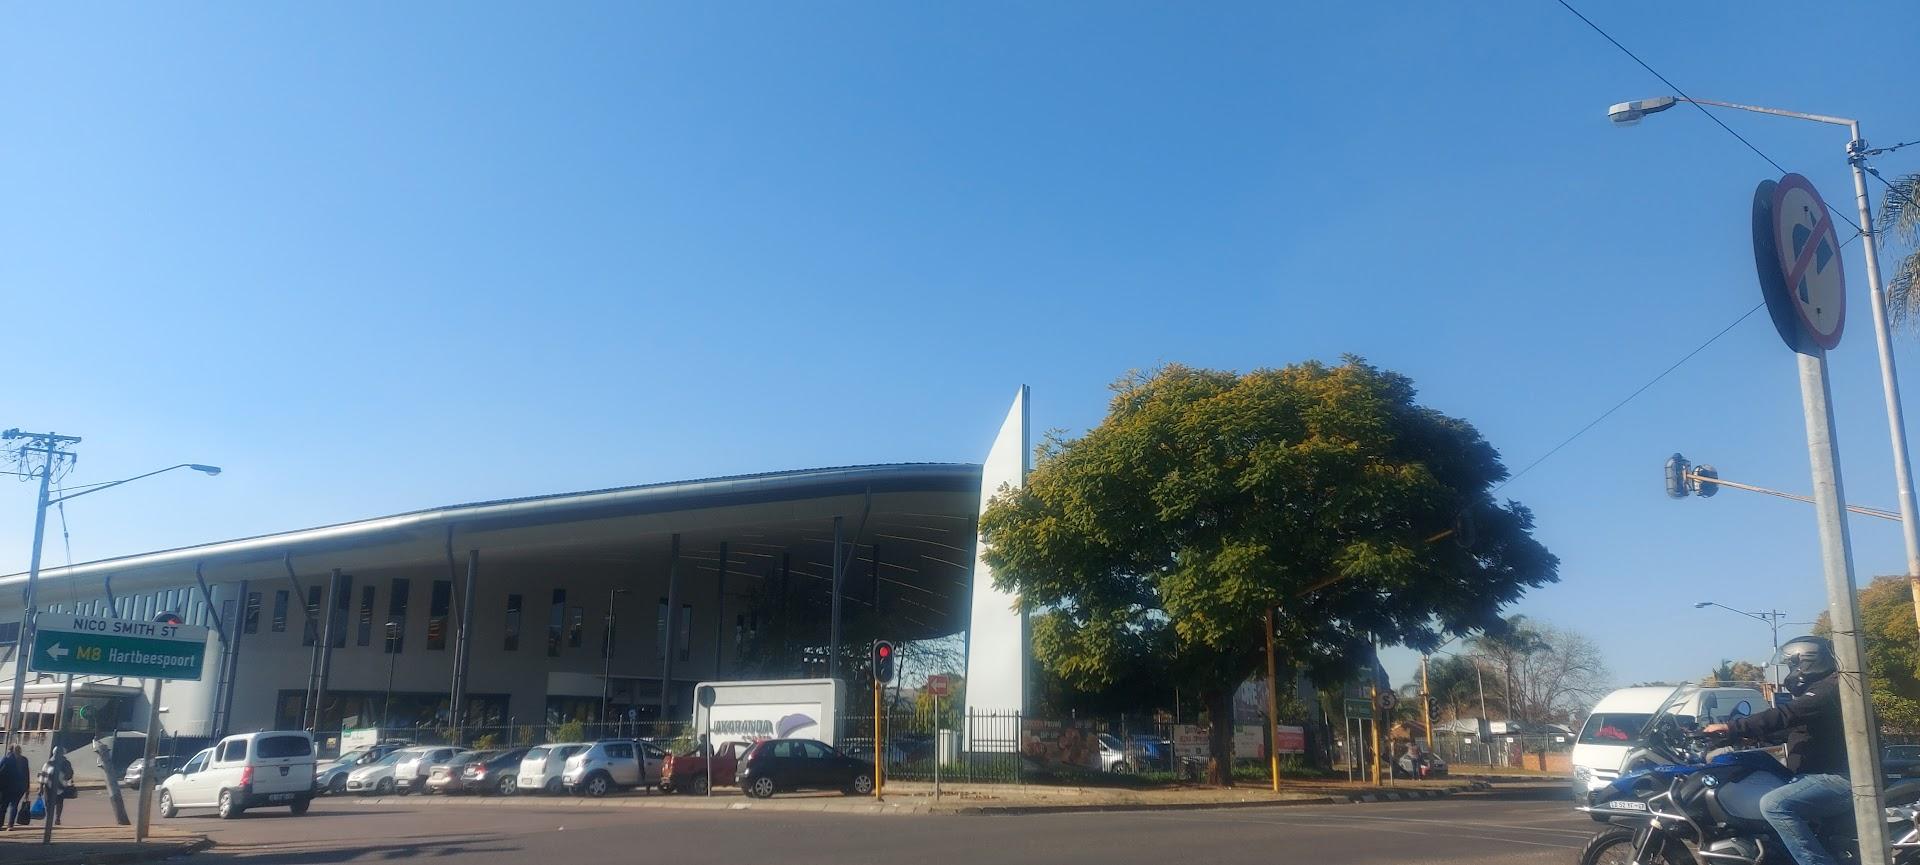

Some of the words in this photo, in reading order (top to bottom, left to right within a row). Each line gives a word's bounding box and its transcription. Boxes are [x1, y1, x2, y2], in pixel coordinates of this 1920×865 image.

[73, 618, 107, 631] NICO
[113, 622, 155, 636] SMITH
[161, 626, 178, 637] ST
[76, 646, 102, 661] M8
[108, 648, 195, 669] Hartbeespoort
